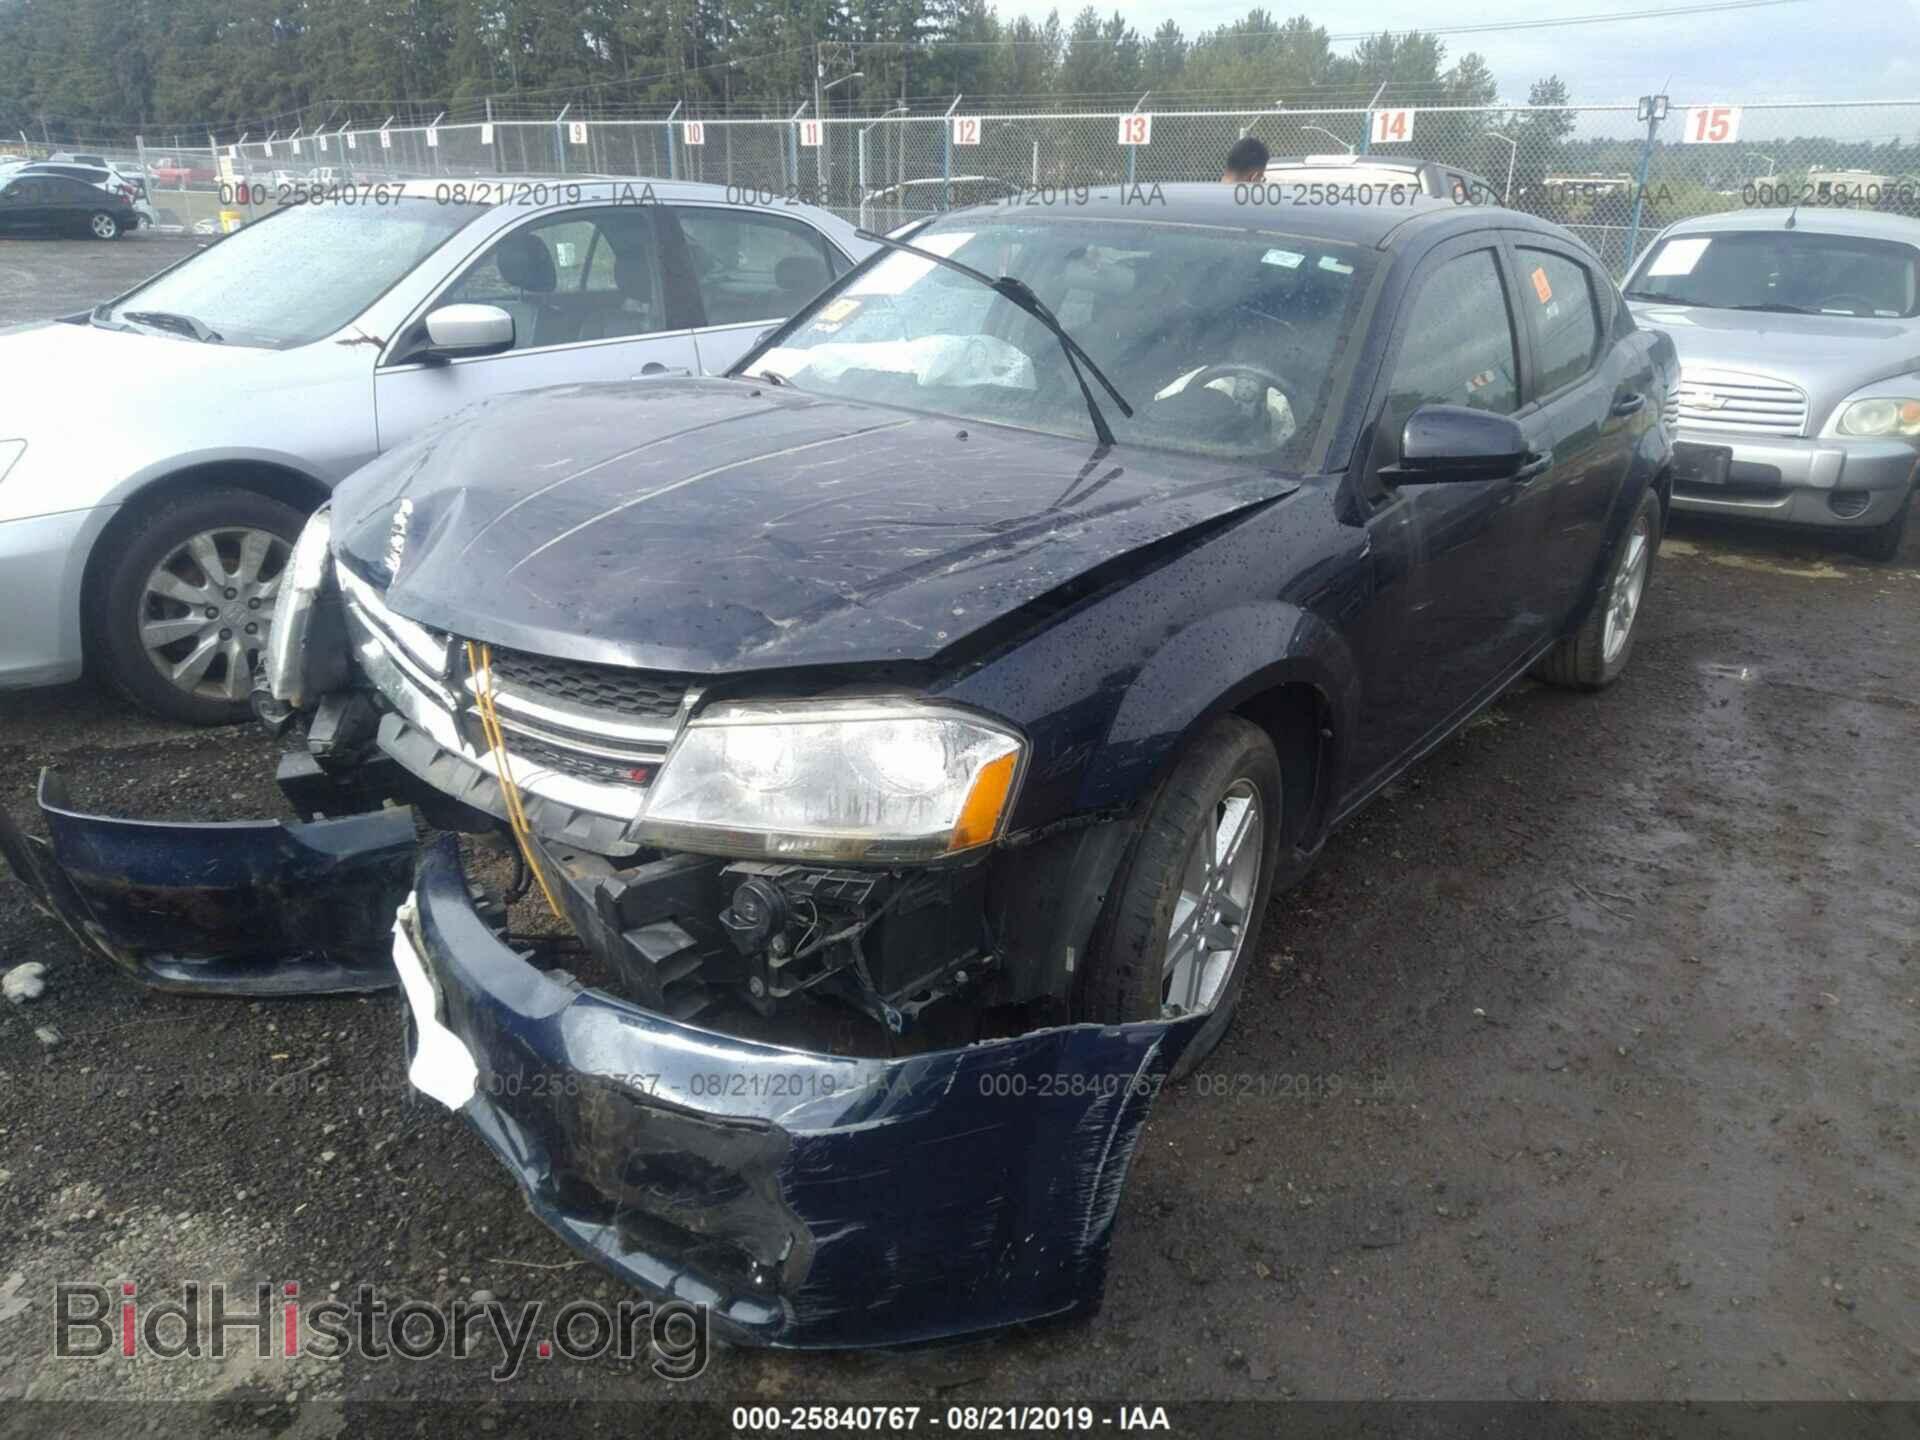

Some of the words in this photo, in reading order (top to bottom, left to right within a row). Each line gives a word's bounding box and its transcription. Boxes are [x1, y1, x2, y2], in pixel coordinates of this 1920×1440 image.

[572, 123, 583, 141] 9
[687, 123, 701, 141] 10
[806, 122, 818, 142] 11
[958, 120, 976, 142] 12
[1124, 117, 1146, 142] 13
[1380, 112, 1407, 140] 14
[1695, 109, 1730, 141] 15
